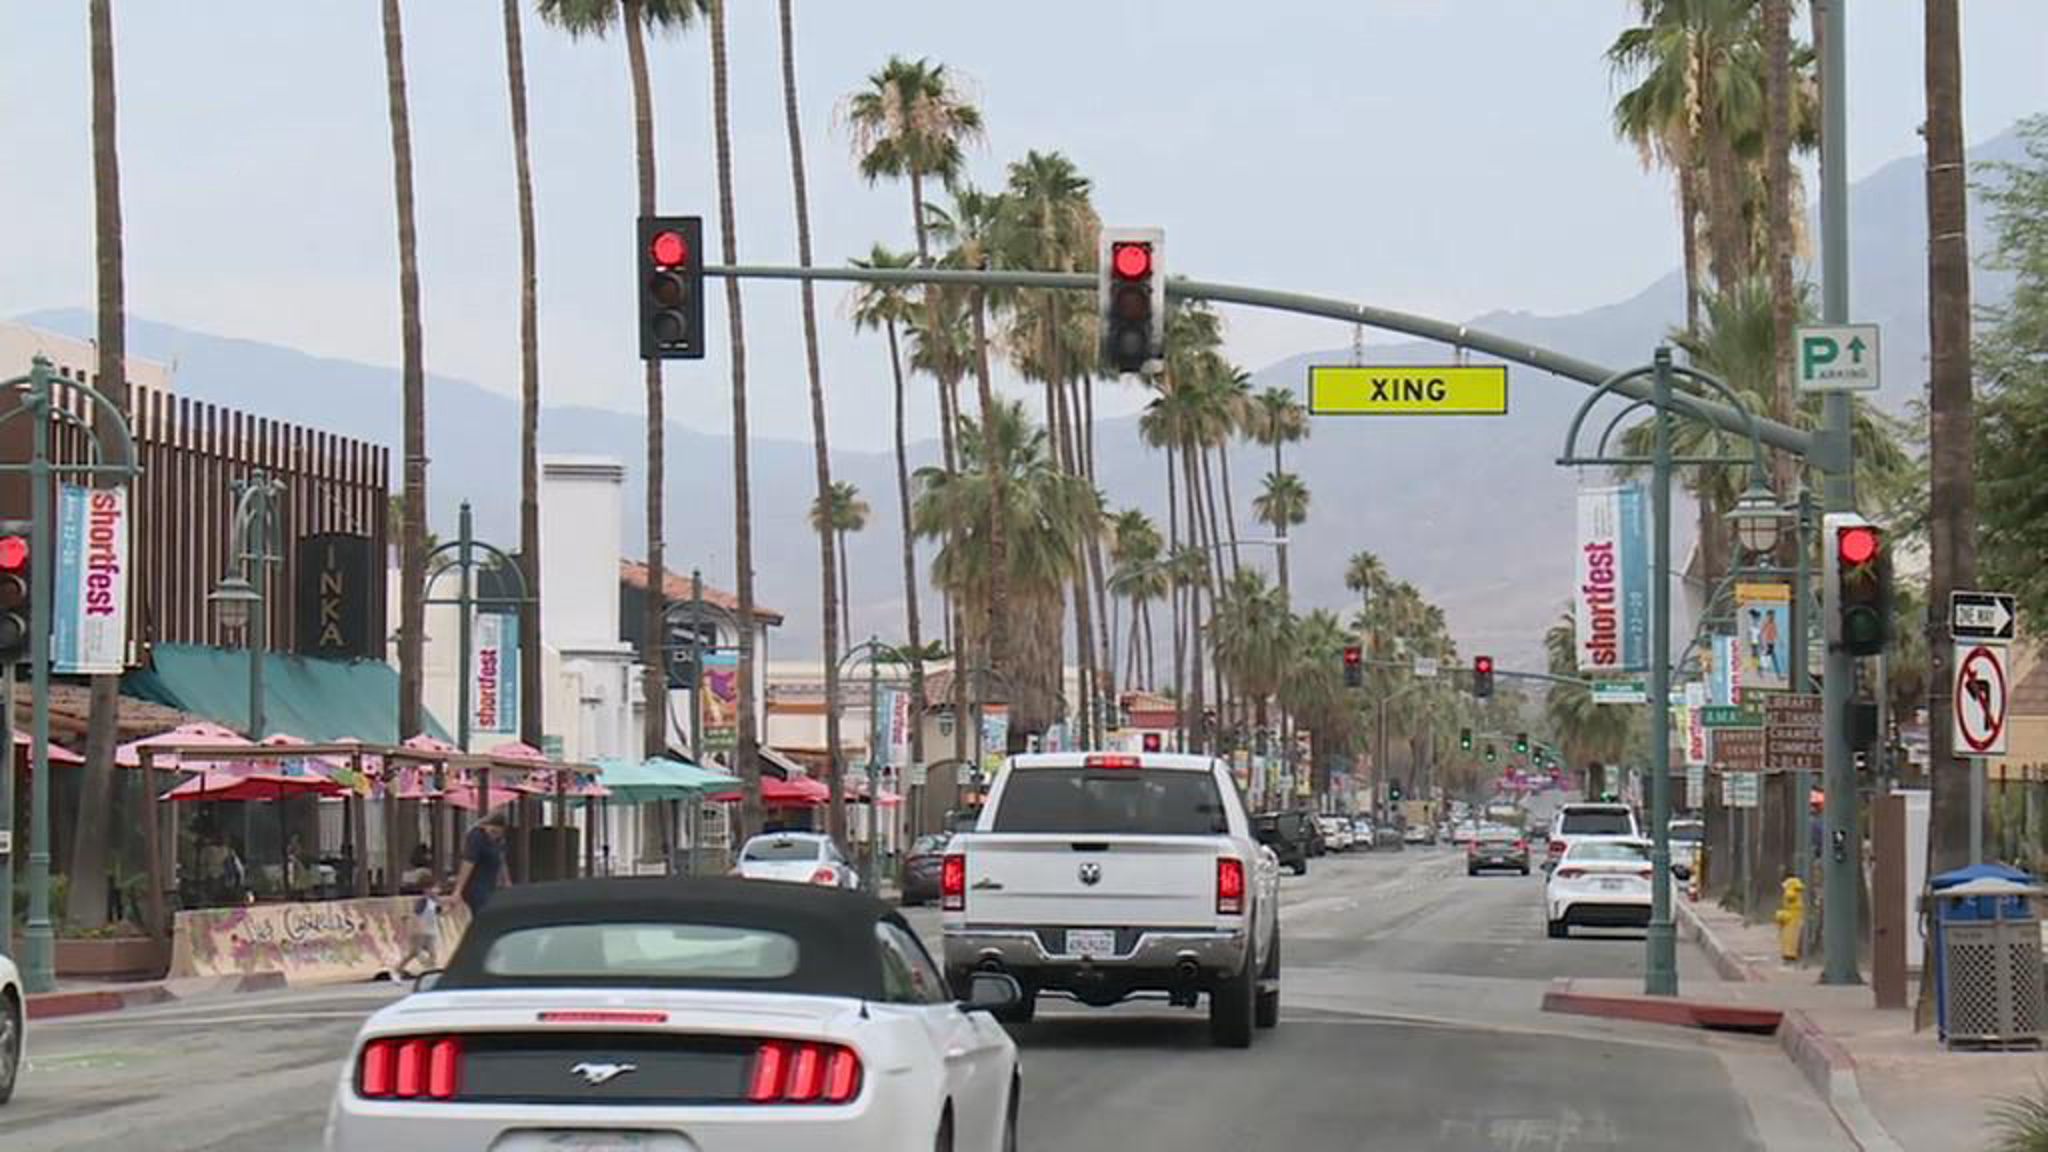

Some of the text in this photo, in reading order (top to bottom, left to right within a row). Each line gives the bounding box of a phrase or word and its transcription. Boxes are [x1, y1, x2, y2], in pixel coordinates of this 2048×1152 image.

[1370, 378, 1446, 401] XING
[85, 492, 121, 615] shortfest
[319, 543, 344, 647] INKA
[1582, 540, 1617, 666] shortfest
[1958, 607, 1975, 624] ONE
